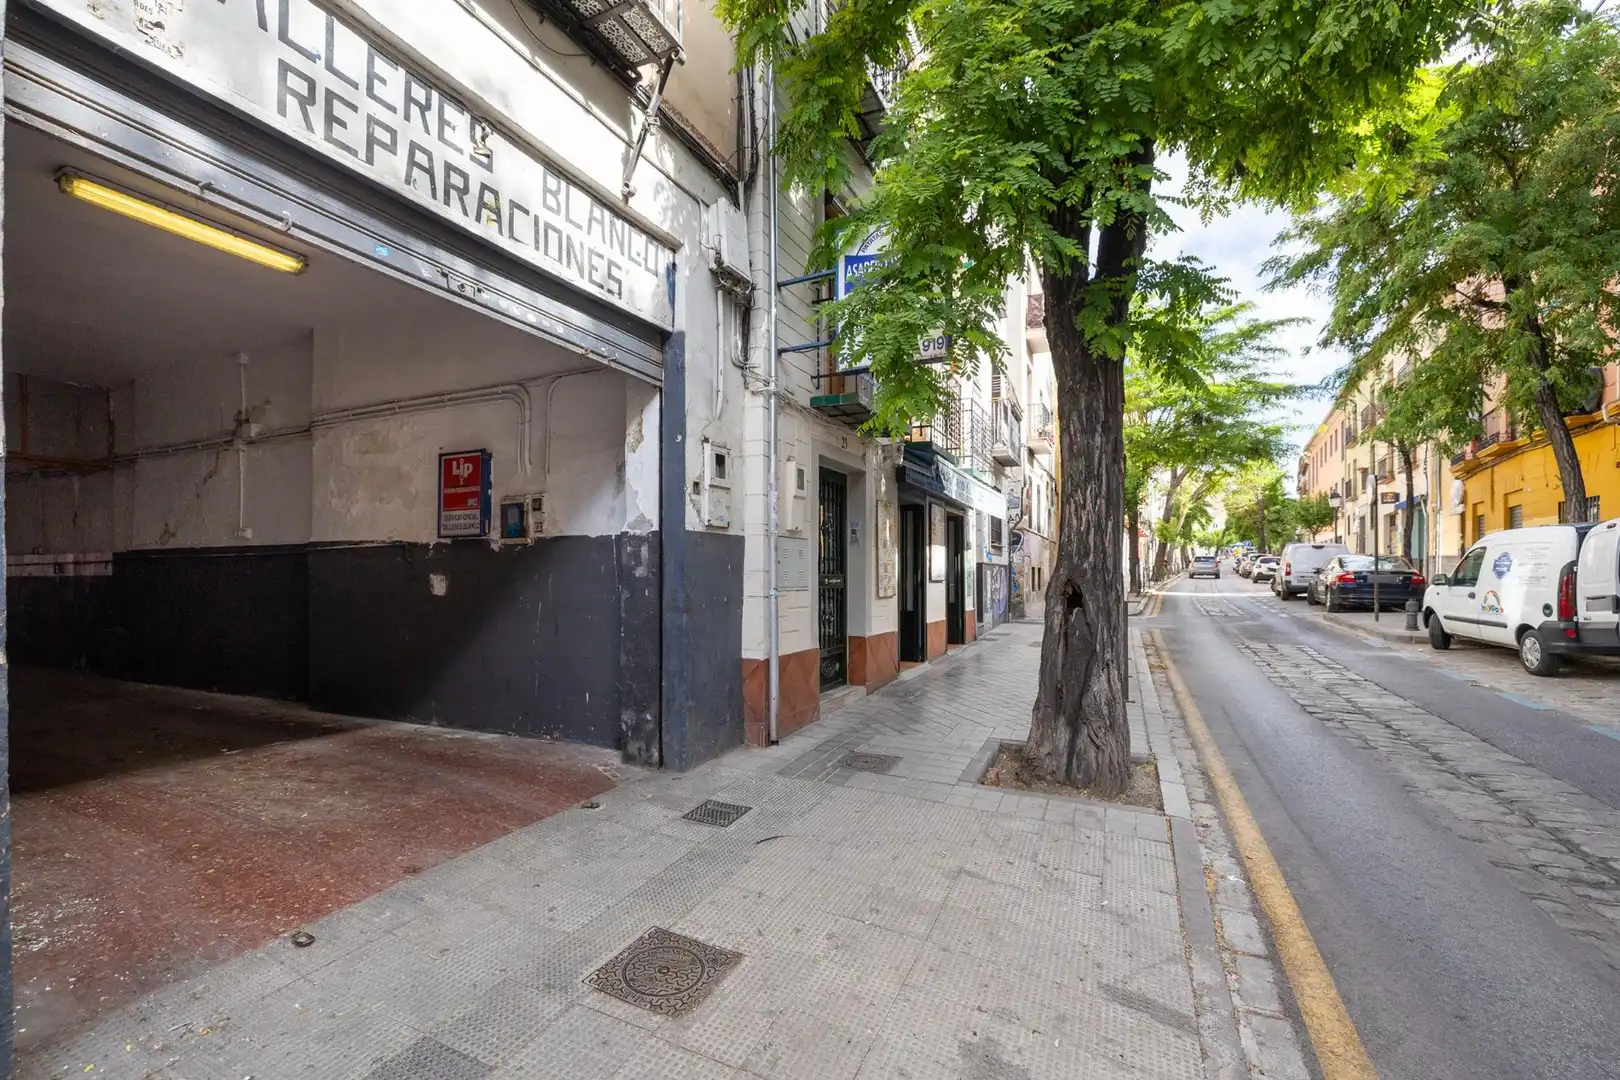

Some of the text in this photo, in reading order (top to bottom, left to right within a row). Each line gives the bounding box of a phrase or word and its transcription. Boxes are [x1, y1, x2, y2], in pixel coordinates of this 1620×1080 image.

[277, 57, 622, 300] REPARACIONES
[542, 168, 659, 278] BLANCO
[861, 230, 885, 253] PATATAS
[841, 436, 848, 450] 23
